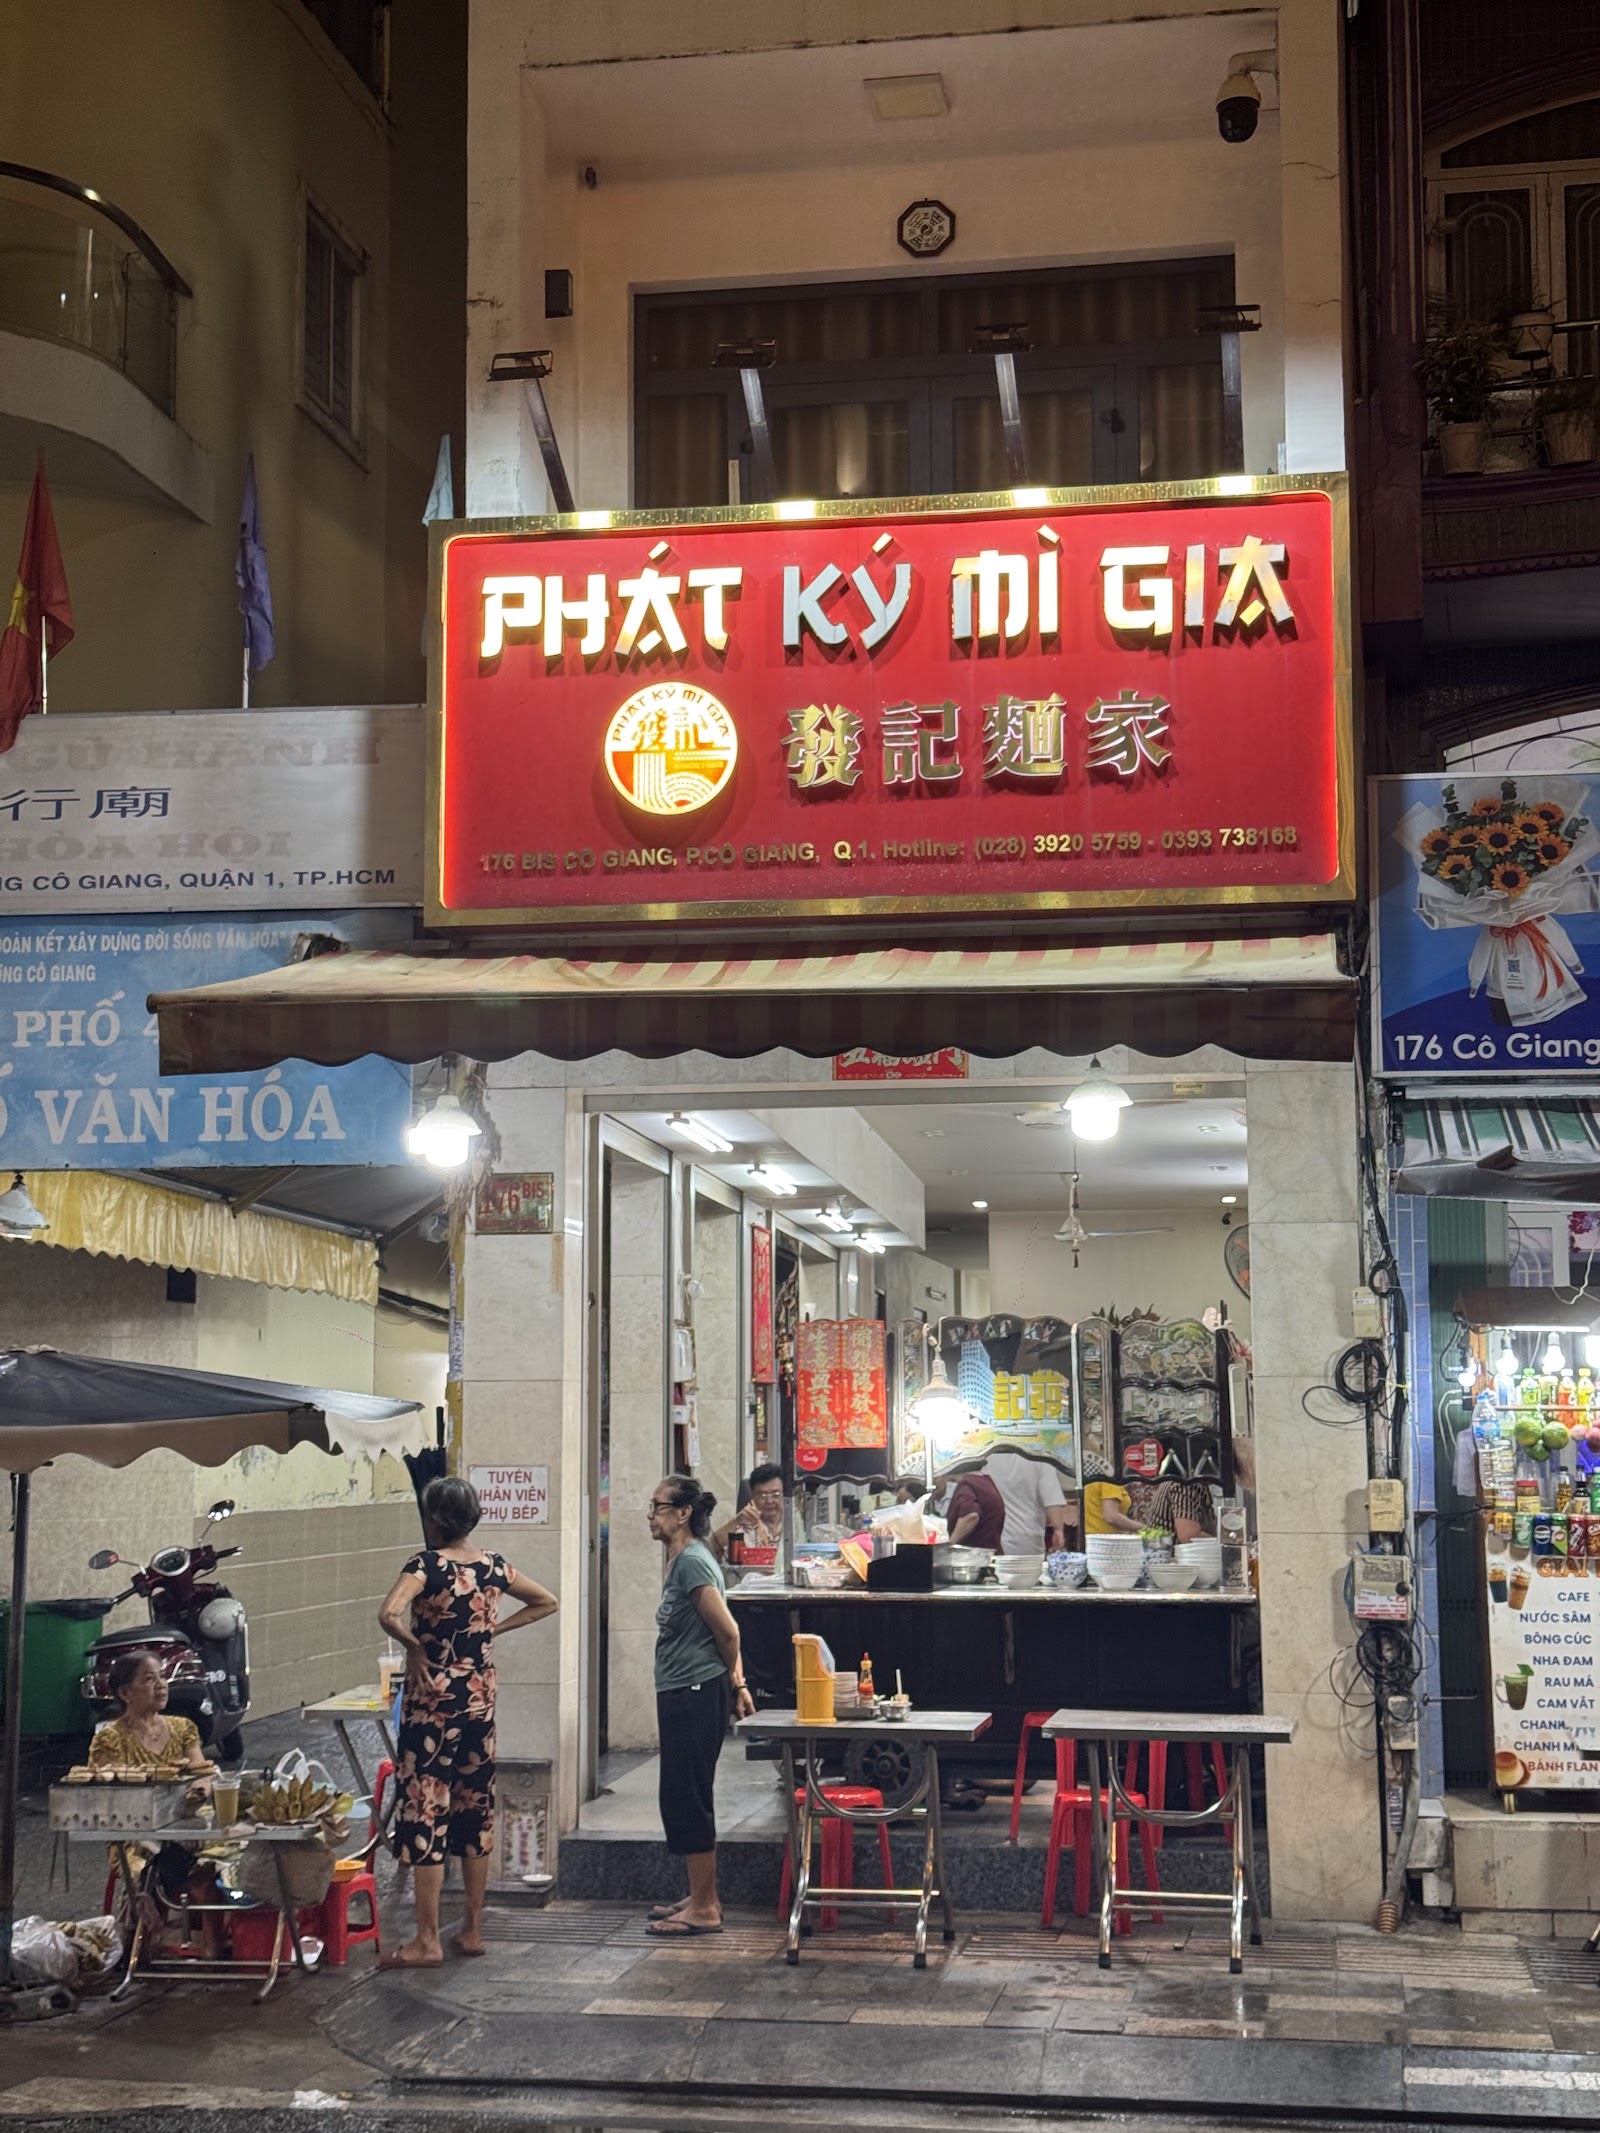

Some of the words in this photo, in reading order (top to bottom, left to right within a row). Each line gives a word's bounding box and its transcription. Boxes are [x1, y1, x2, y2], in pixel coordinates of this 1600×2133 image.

[482, 541, 744, 658] PHÁT
[783, 534, 912, 649] KÝ
[951, 524, 1063, 640] MÌ
[1099, 536, 1293, 639] GIA
[780, 690, 1173, 788] 發記麵家
[480, 851, 515, 871] 176
[522, 851, 556, 870] BIS
[563, 847, 595, 869] CÔ
[602, 847, 678, 868] GIANG,
[686, 841, 737, 866] P.CÔ
[743, 842, 820, 864] GIANG,
[883, 836, 965, 859] Hotline:
[974, 835, 1026, 858] (028)
[1033, 834, 1083, 853] 3920
[1091, 831, 1142, 851] 5759
[1161, 829, 1212, 849] 0393
[1219, 826, 1297, 847] 738168
[33, 872, 70, 890] CÔ
[78, 873, 170, 891] GIANG,
[179, 868, 255, 891] QUẬN
[264, 873, 285, 890] 1,
[294, 869, 395, 887] TP.HCM
[0, 931, 31, 954] OÀN
[36, 929, 64, 953] KẾT
[68, 930, 96, 952] XÂY
[100, 930, 140, 956] DỰNG
[145, 928, 169, 950] ĐỜI
[173, 925, 212, 950] SỐNG
[27, 961, 46, 982] CÔ
[50, 964, 97, 982] GIANG
[12, 990, 125, 1047] PHỐ
[1394, 1034, 1443, 1061] 176
[1452, 1034, 1496, 1060] Cô
[1506, 1033, 1600, 1065] Giang
[35, 1072, 176, 1145] VĂN
[198, 1068, 346, 1142] HÓA
[515, 1486, 546, 1501] VIÊN
[1557, 1592, 1590, 1602] CAFE
[1524, 1632, 1561, 1644] BÔNG
[1564, 1632, 1592, 1644] CÚC
[1533, 1656, 1560, 1666] NHA
[1563, 1656, 1593, 1666] ĐAM
[1544, 1677, 1572, 1687] RAU
[1573, 1674, 1594, 1687] MÁ
[1536, 1698, 1567, 1709] CAM
[1514, 1741, 1560, 1751] CHANH
[1528, 1758, 1563, 1771] BÁNH
[1566, 1762, 1598, 1772] FLAN
